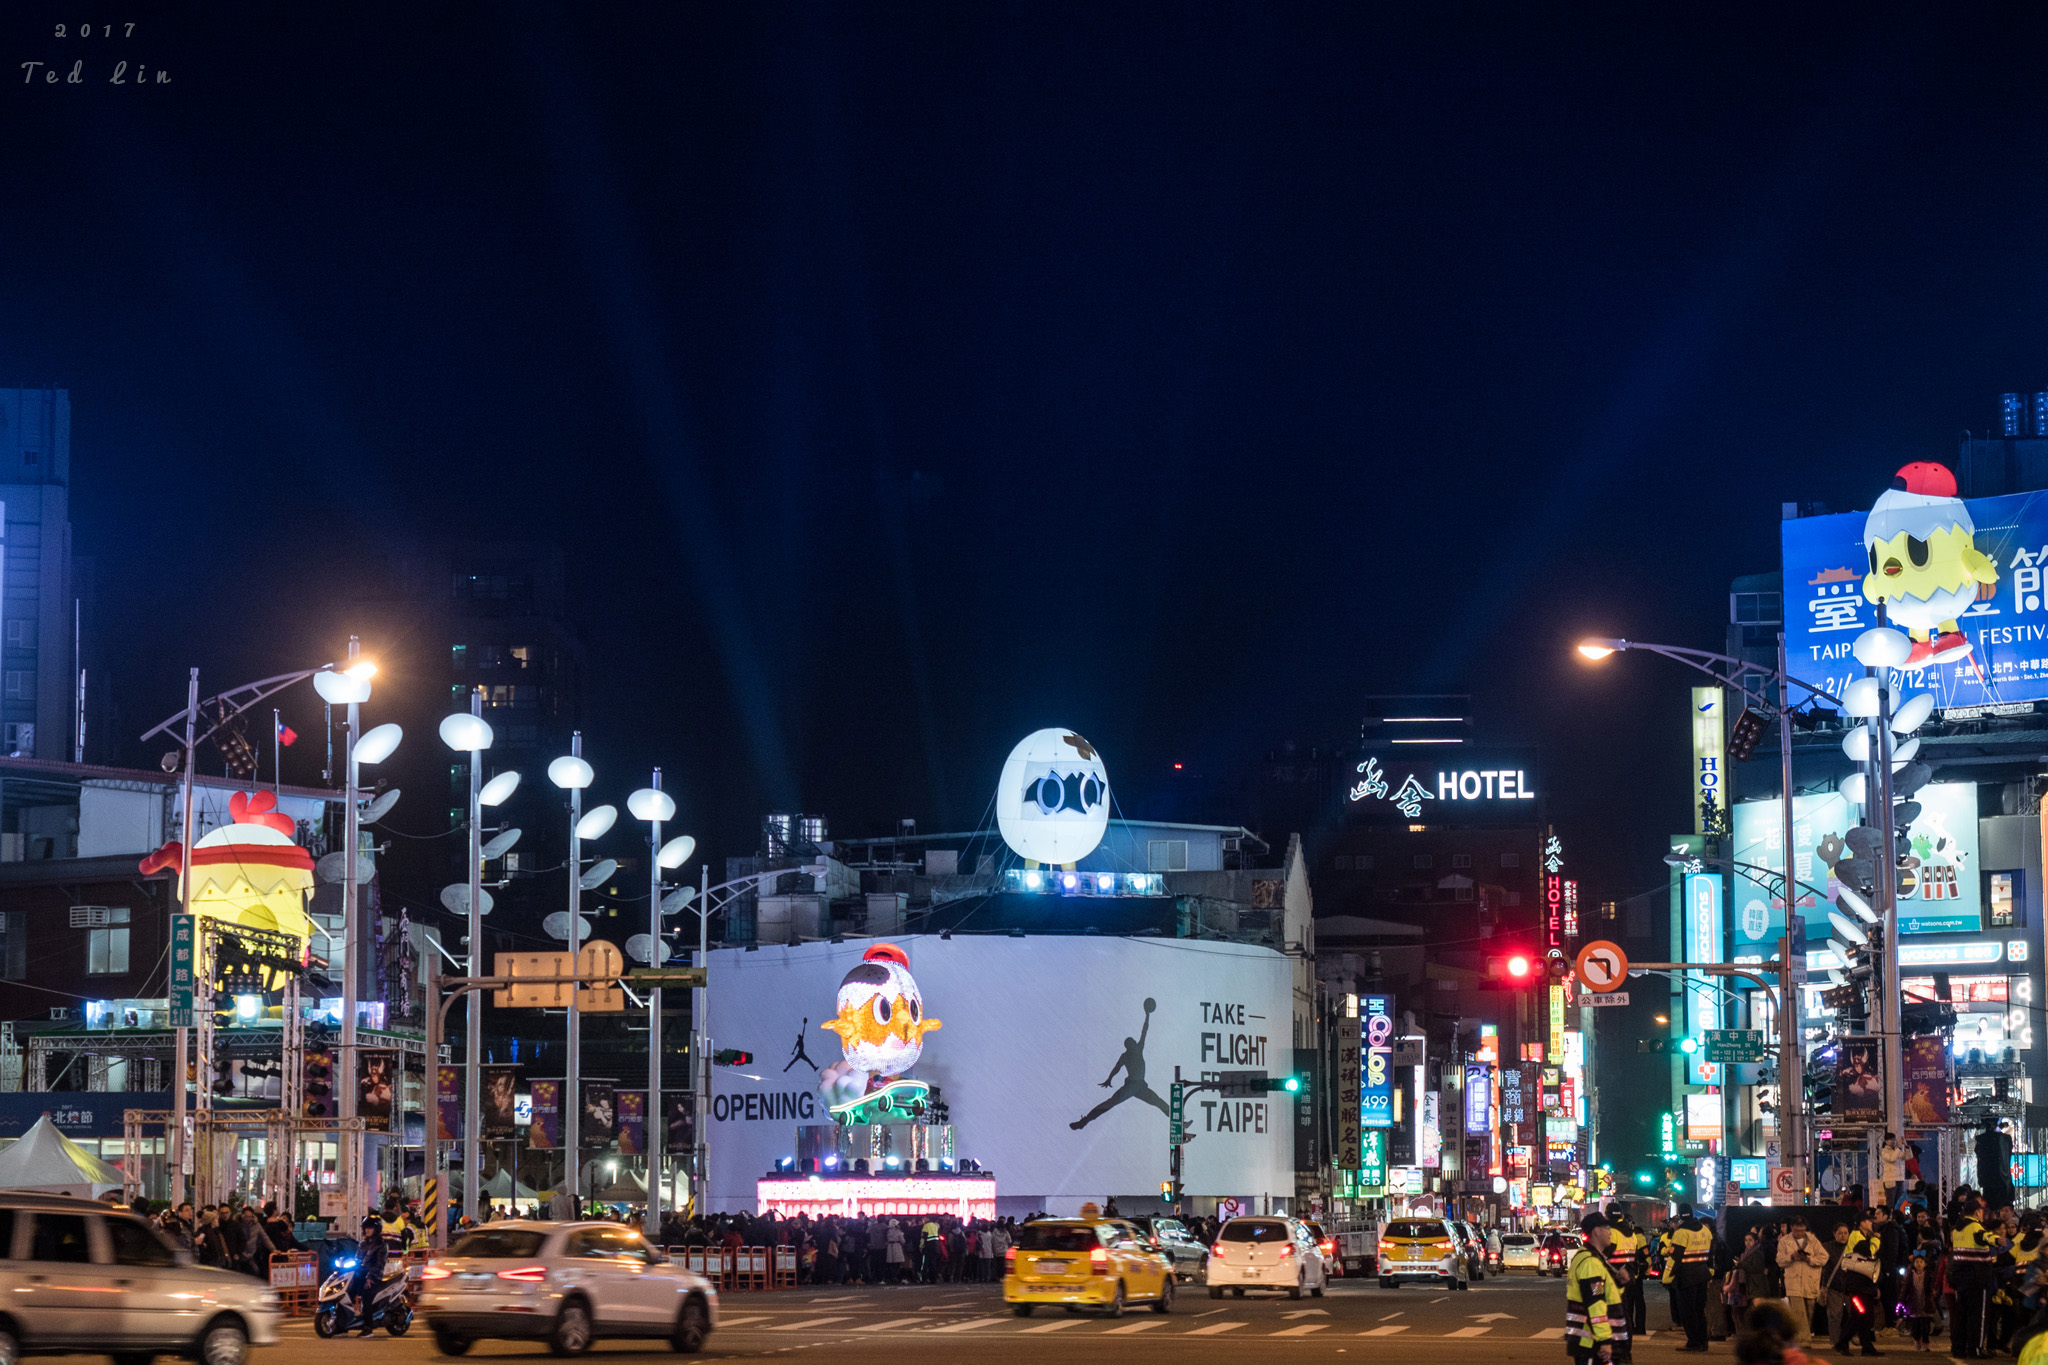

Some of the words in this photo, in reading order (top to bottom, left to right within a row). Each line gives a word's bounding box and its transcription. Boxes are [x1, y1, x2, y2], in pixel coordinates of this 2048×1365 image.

[1809, 642, 1857, 661] TAIP
[1980, 624, 2048, 646] FESTIV
[1438, 770, 1535, 800] HOTEL
[1547, 876, 1561, 946] HOTEL
[176, 928, 189, 981] 成都路
[1900, 948, 1958, 962] watsons
[171, 984, 193, 993] Cheng
[1582, 996, 1626, 1005] 公車除外
[1200, 1001, 1245, 1026] TAKE
[1201, 1031, 1268, 1066] FLIGHT
[1711, 1031, 1757, 1041] 漢中街
[713, 1090, 814, 1122] OPENING
[1300, 1070, 1312, 1126] 門卡迪咖啡
[1362, 1096, 1388, 1109] 499
[1201, 1101, 1268, 1134] TAIPEI
[1362, 1178, 1380, 1186] CD
